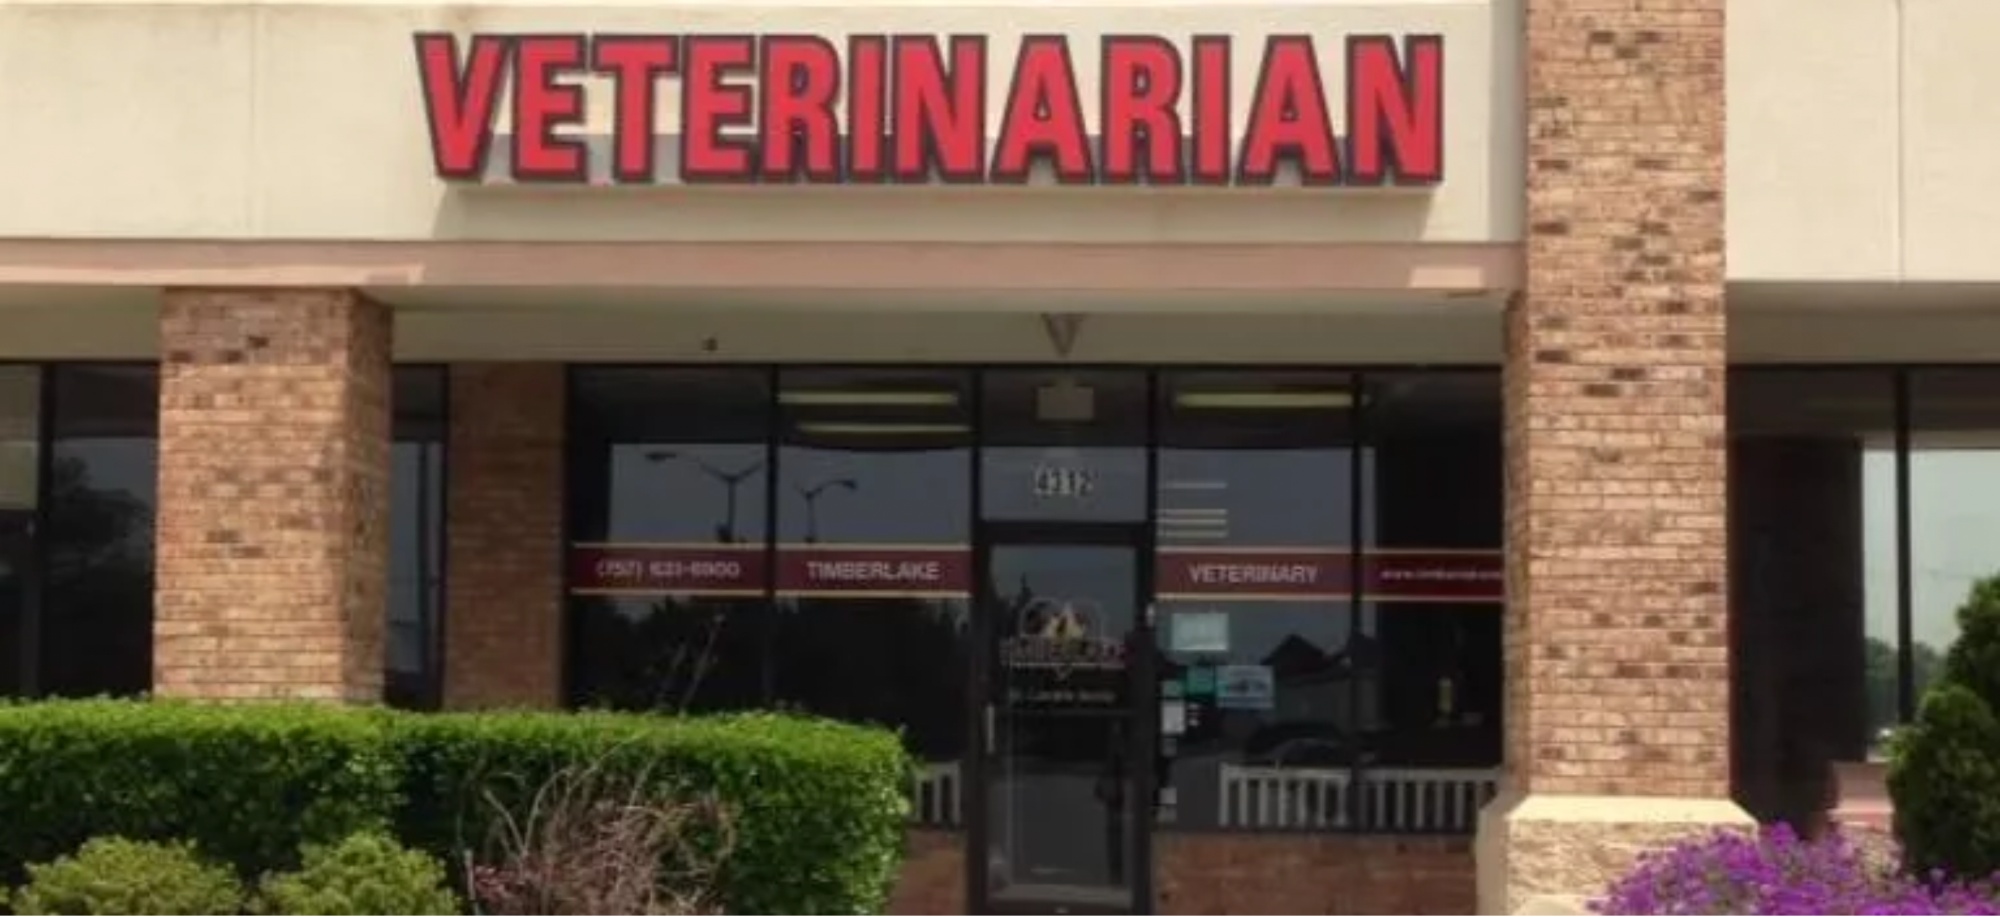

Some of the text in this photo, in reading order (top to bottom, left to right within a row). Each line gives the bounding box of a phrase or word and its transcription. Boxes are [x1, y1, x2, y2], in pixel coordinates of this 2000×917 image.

[413, 33, 1444, 184] VETERINARIAN
[805, 560, 941, 581] TIMBERLAKE
[1187, 563, 1320, 583] VETERINARY
